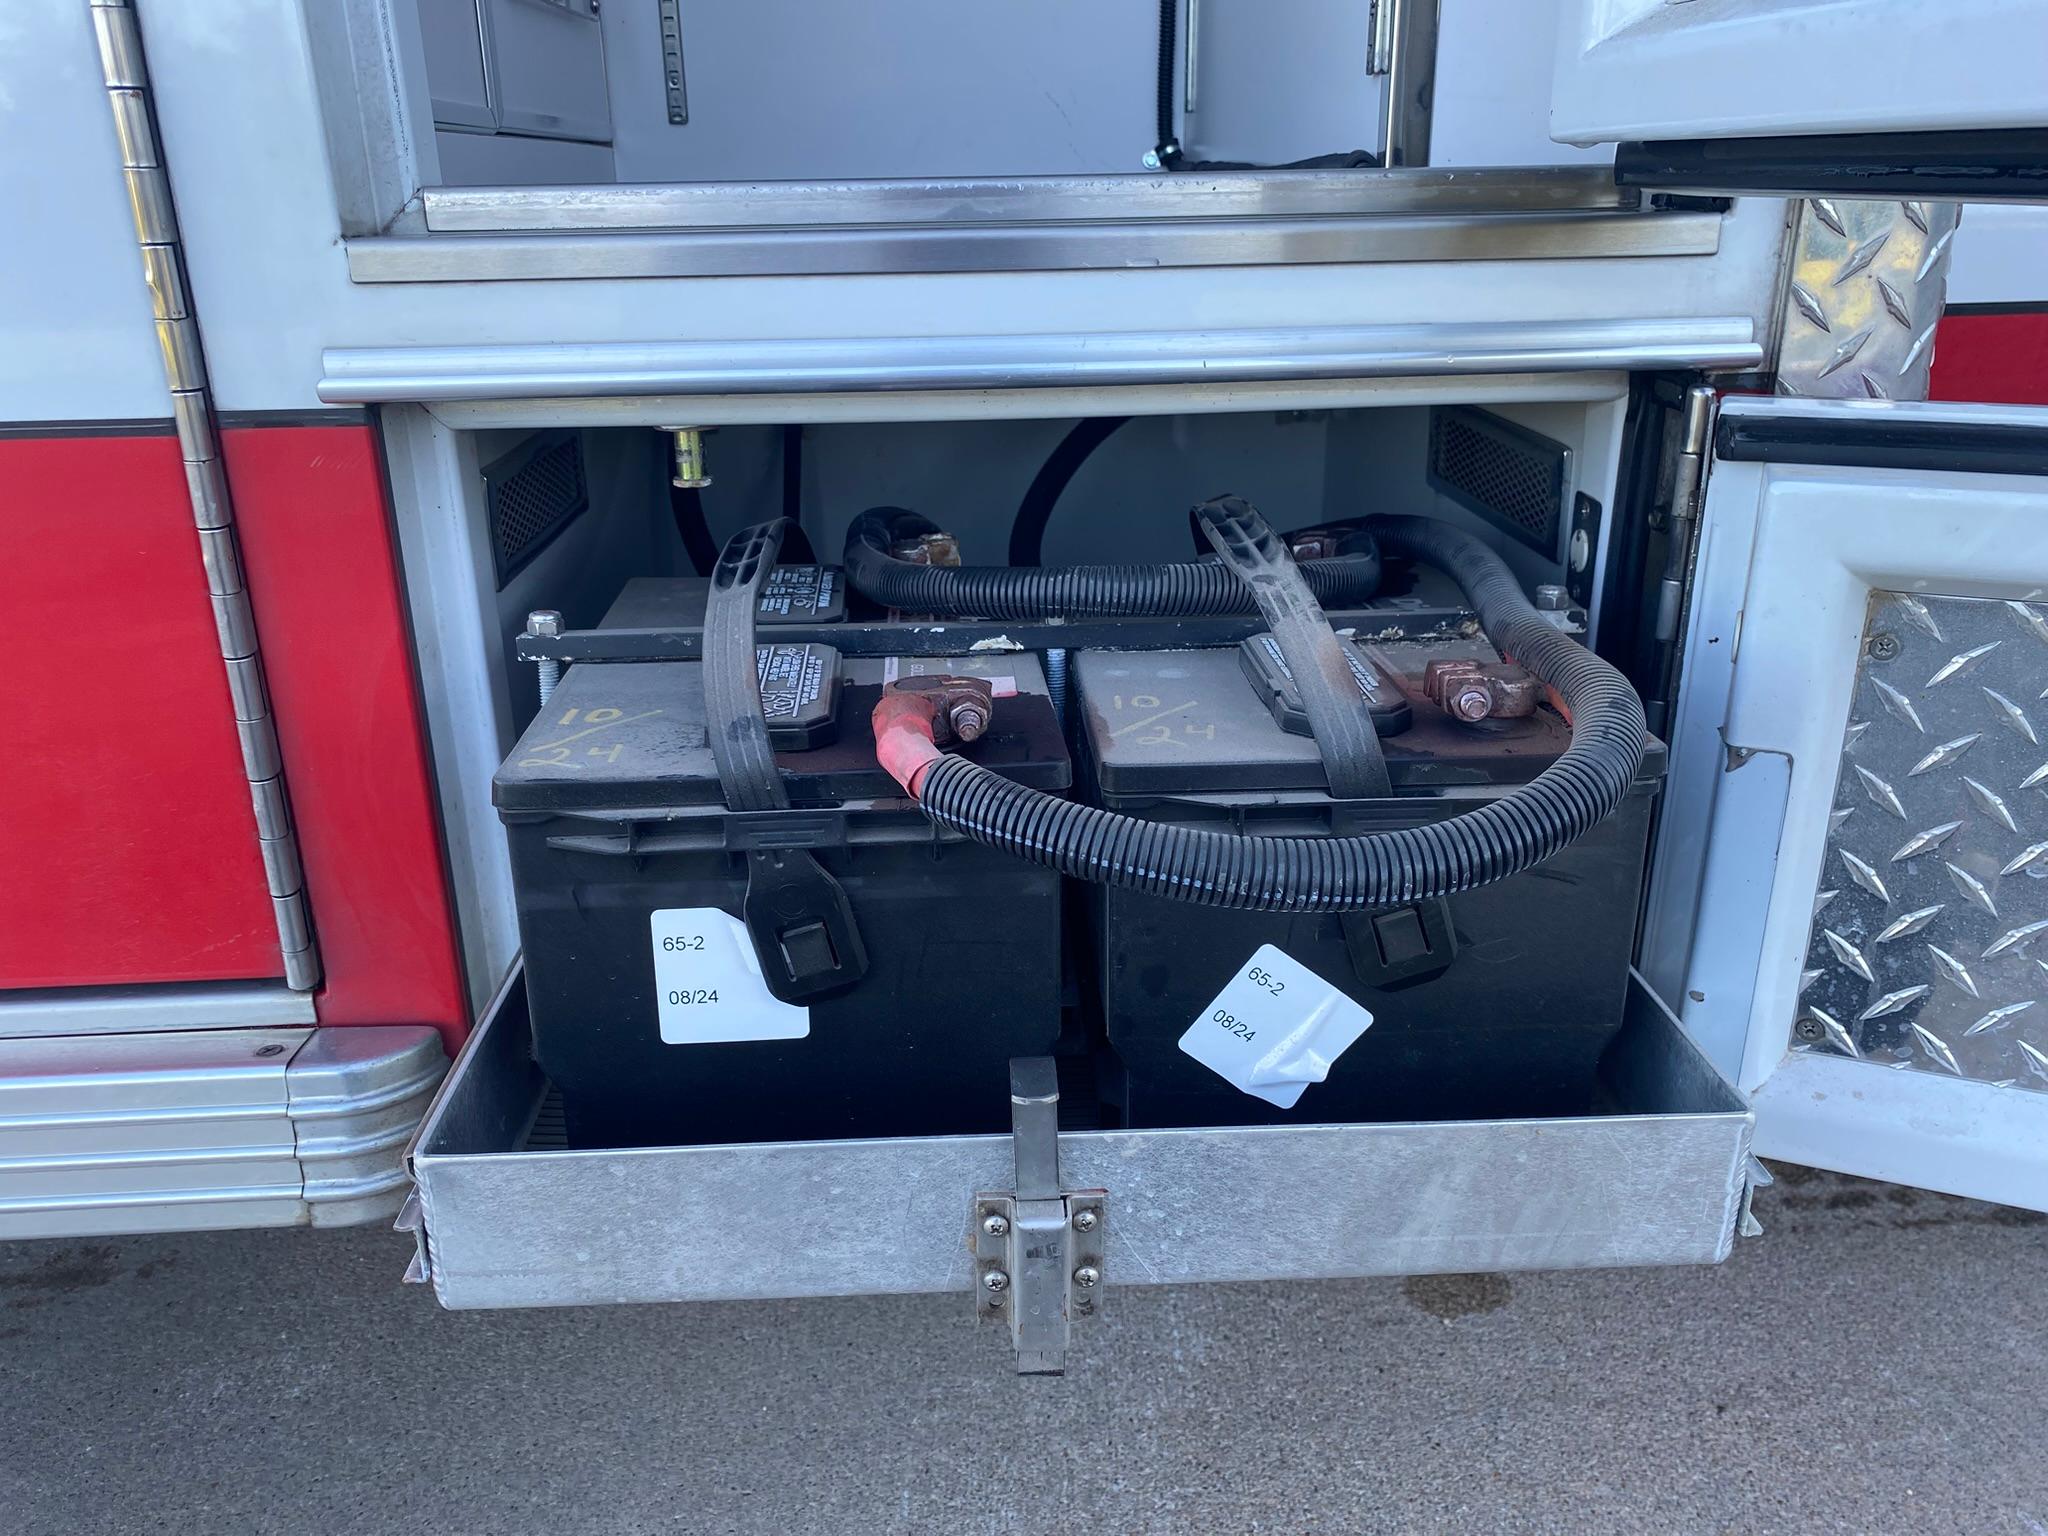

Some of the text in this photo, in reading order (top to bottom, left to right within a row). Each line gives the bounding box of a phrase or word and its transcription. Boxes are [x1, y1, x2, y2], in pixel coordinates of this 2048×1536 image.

[663, 936, 704, 951] 65-2
[1248, 967, 1285, 996] 65-2
[669, 990, 718, 1004] 08/24
[1213, 1009, 1256, 1042] 08/24
